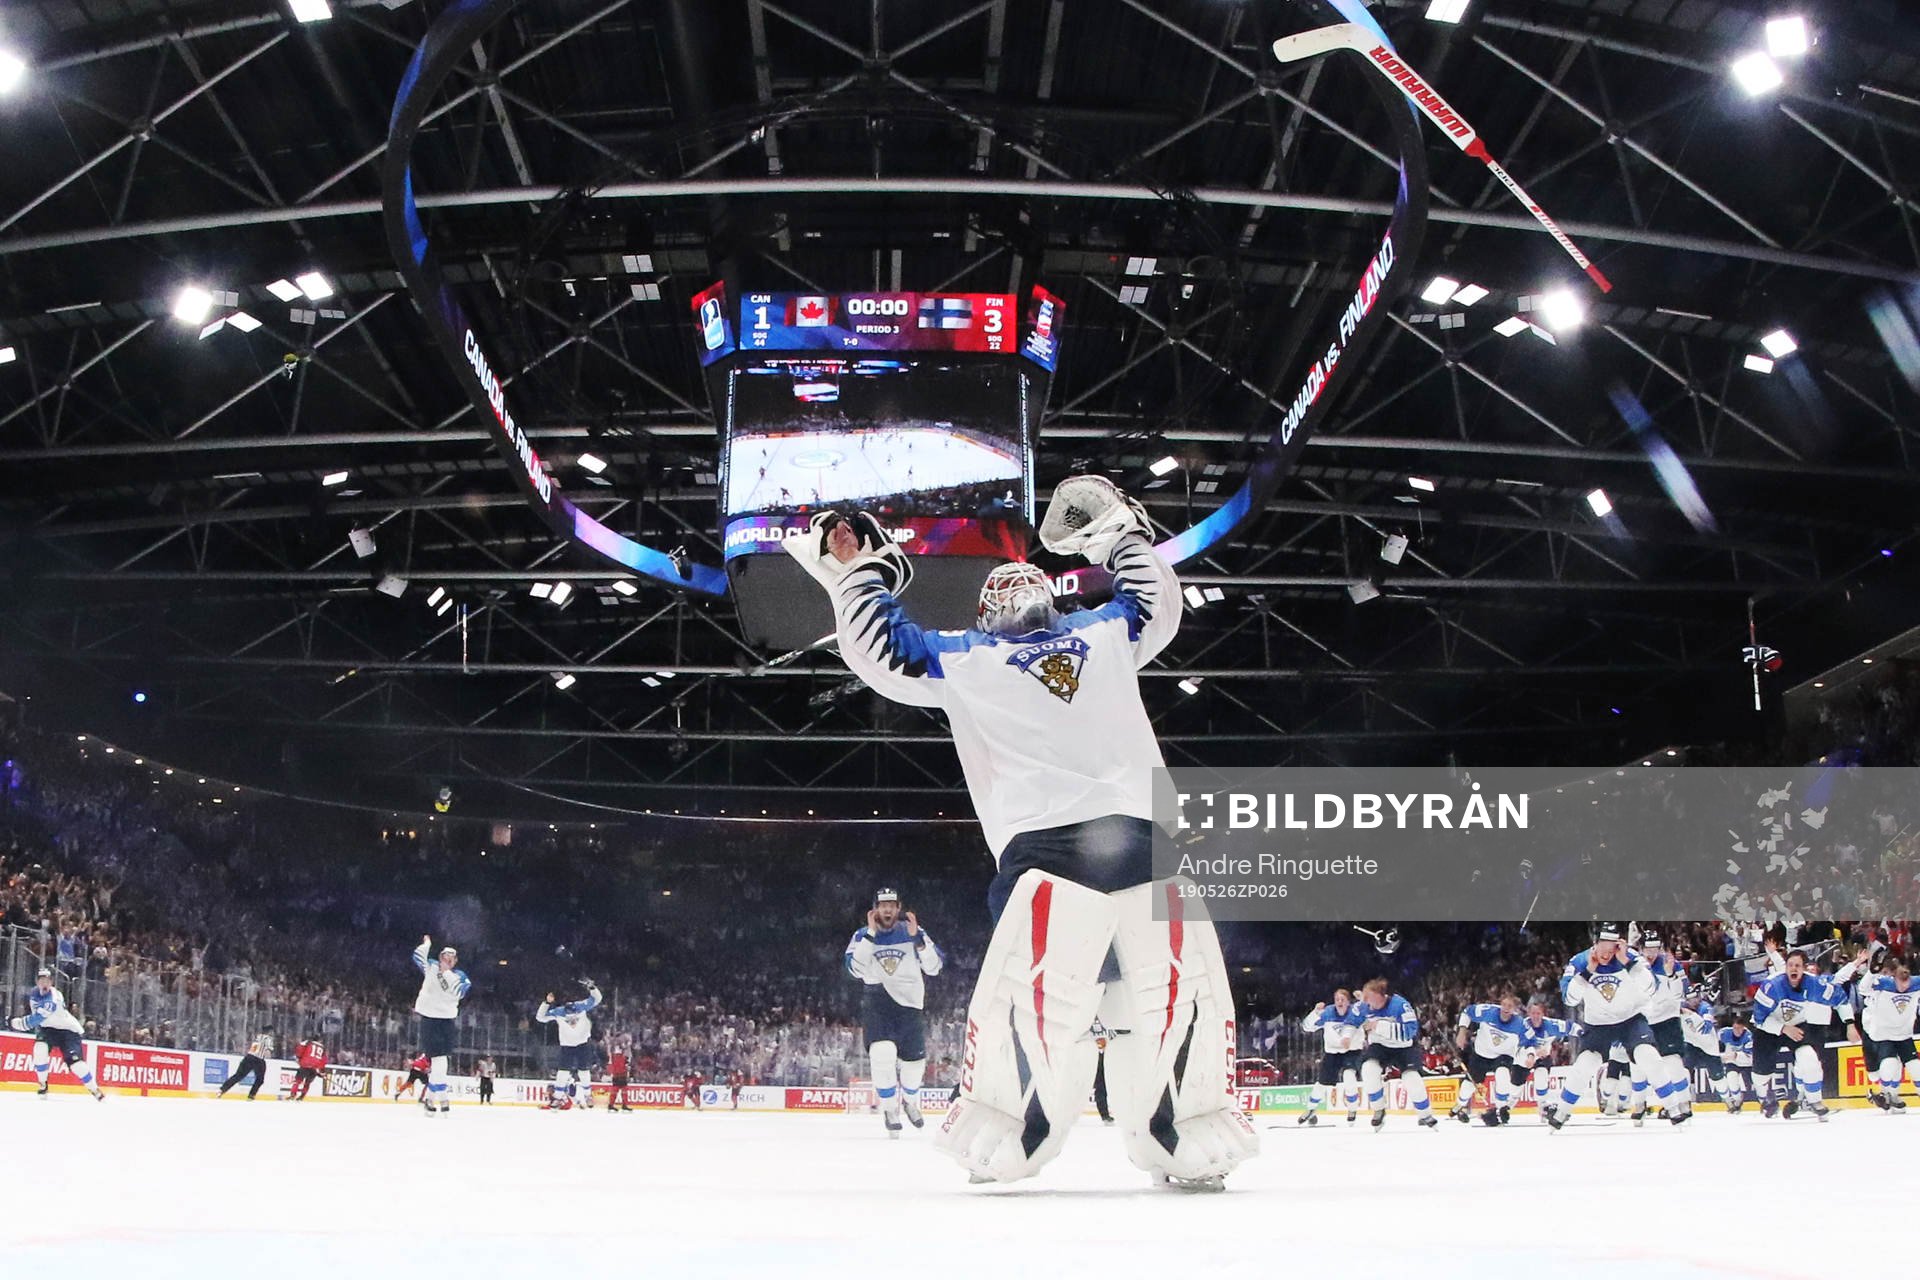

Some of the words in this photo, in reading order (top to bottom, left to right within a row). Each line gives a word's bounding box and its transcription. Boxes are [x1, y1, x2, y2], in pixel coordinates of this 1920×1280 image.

[1369, 45, 1471, 138] WARRIOR
[750, 295, 771, 304] CAN
[848, 299, 908, 315] 00:00
[986, 298, 1004, 307] FIN
[754, 306, 771, 330] 1
[856, 325, 891, 334] PERIOD
[893, 326, 900, 334] 3
[983, 310, 1003, 333] 3
[988, 342, 1001, 350] 22
[1281, 360, 1325, 445] CANADA
[1324, 342, 1341, 373] vs.
[1338, 236, 1394, 348] FINLAND
[464, 328, 504, 421] CANADA
[515, 426, 551, 504] FINLAND
[728, 527, 783, 546] WORLD
[1016, 639, 1083, 663] SUOMI
[310, 1045, 324, 1059] 19
[962, 1016, 980, 1093] CCM
[1225, 1019, 1235, 1095] CCM
[102, 1063, 183, 1086] #BRATISLAVA
[801, 1090, 867, 1104] PATRON
